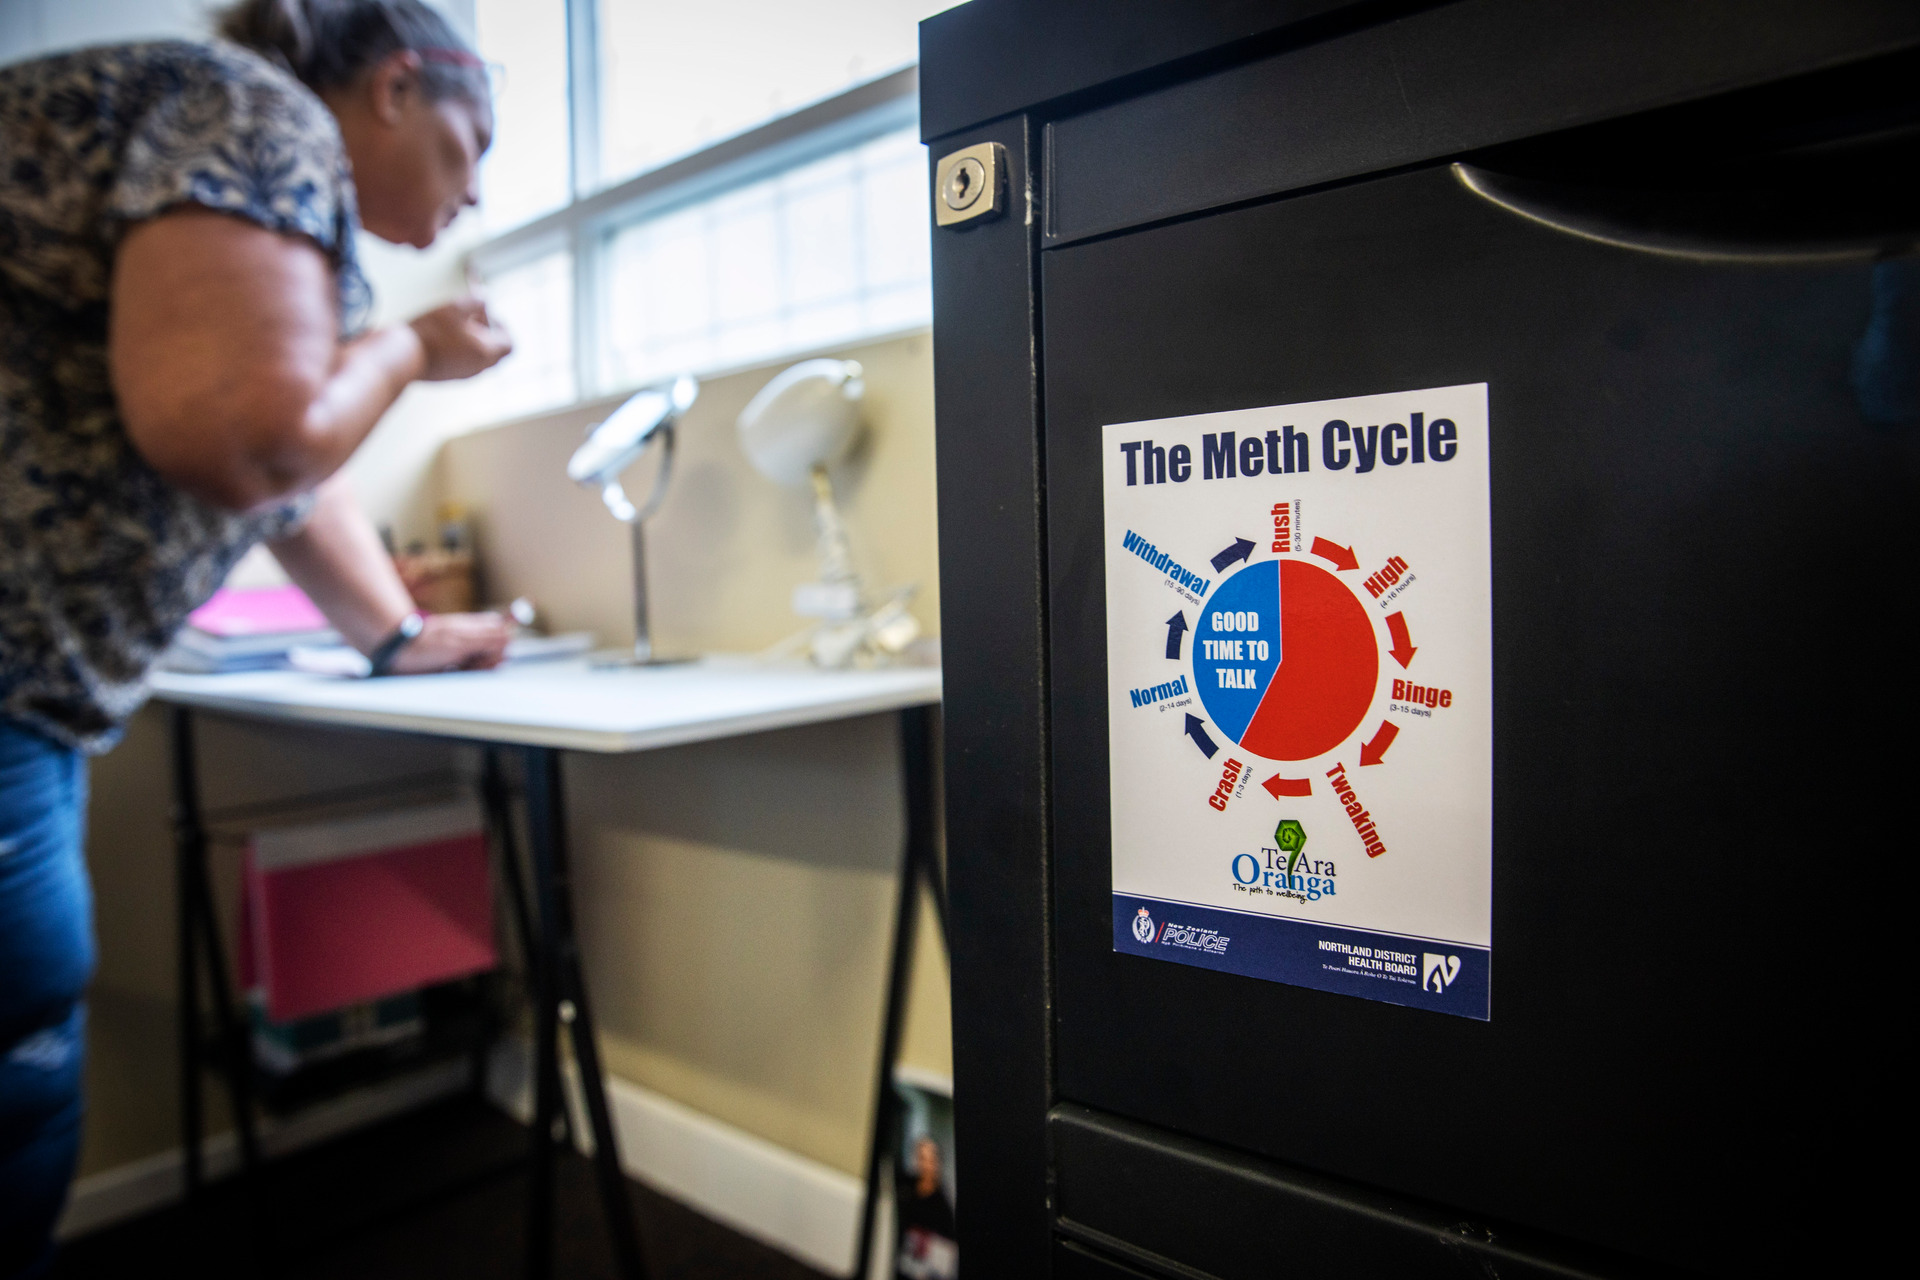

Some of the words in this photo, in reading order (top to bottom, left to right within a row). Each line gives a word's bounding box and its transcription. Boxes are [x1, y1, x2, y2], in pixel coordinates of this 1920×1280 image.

[1120, 440, 1192, 487] The
[1202, 425, 1310, 480] Meth
[1322, 412, 1458, 474] Cycle
[1271, 502, 1291, 553] Rush
[1293, 498, 1302, 531] minutes)
[1294, 532, 1302, 552] (5-30
[1122, 529, 1211, 598] Withdrawal
[1362, 555, 1409, 600] High
[1184, 592, 1201, 606] days)
[1380, 591, 1398, 609] (4-16
[1394, 573, 1417, 594] hours)
[1211, 611, 1260, 633] GOOD
[1202, 640, 1244, 661] TIME
[1246, 640, 1270, 662] TO
[1129, 674, 1189, 709] Normal
[1215, 668, 1257, 690] TALK
[1391, 678, 1453, 709] Binge
[1159, 702, 1175, 713] (2-14
[1175, 697, 1192, 708] days)
[1389, 703, 1410, 714] (3-15
[1410, 707, 1432, 718] days)
[1208, 757, 1244, 812] Crash
[1235, 783, 1245, 799] (1-3
[1241, 766, 1254, 785] days)
[1325, 761, 1387, 859] Tweaking
[1261, 847, 1288, 871] Te
[1293, 852, 1337, 877] Ara
[1231, 853, 1337, 902] Oranga
[1232, 883, 1247, 892] The
[1249, 886, 1264, 896] path
[1266, 888, 1274, 896] to
[1162, 928, 1231, 951] POLICE
[1186, 926, 1219, 935] Zealand
[1318, 940, 1373, 958] NORTHLAND
[1374, 949, 1418, 965] DISTRICT
[1348, 956, 1383, 971] HEALTH
[1384, 962, 1418, 977] BOARD
